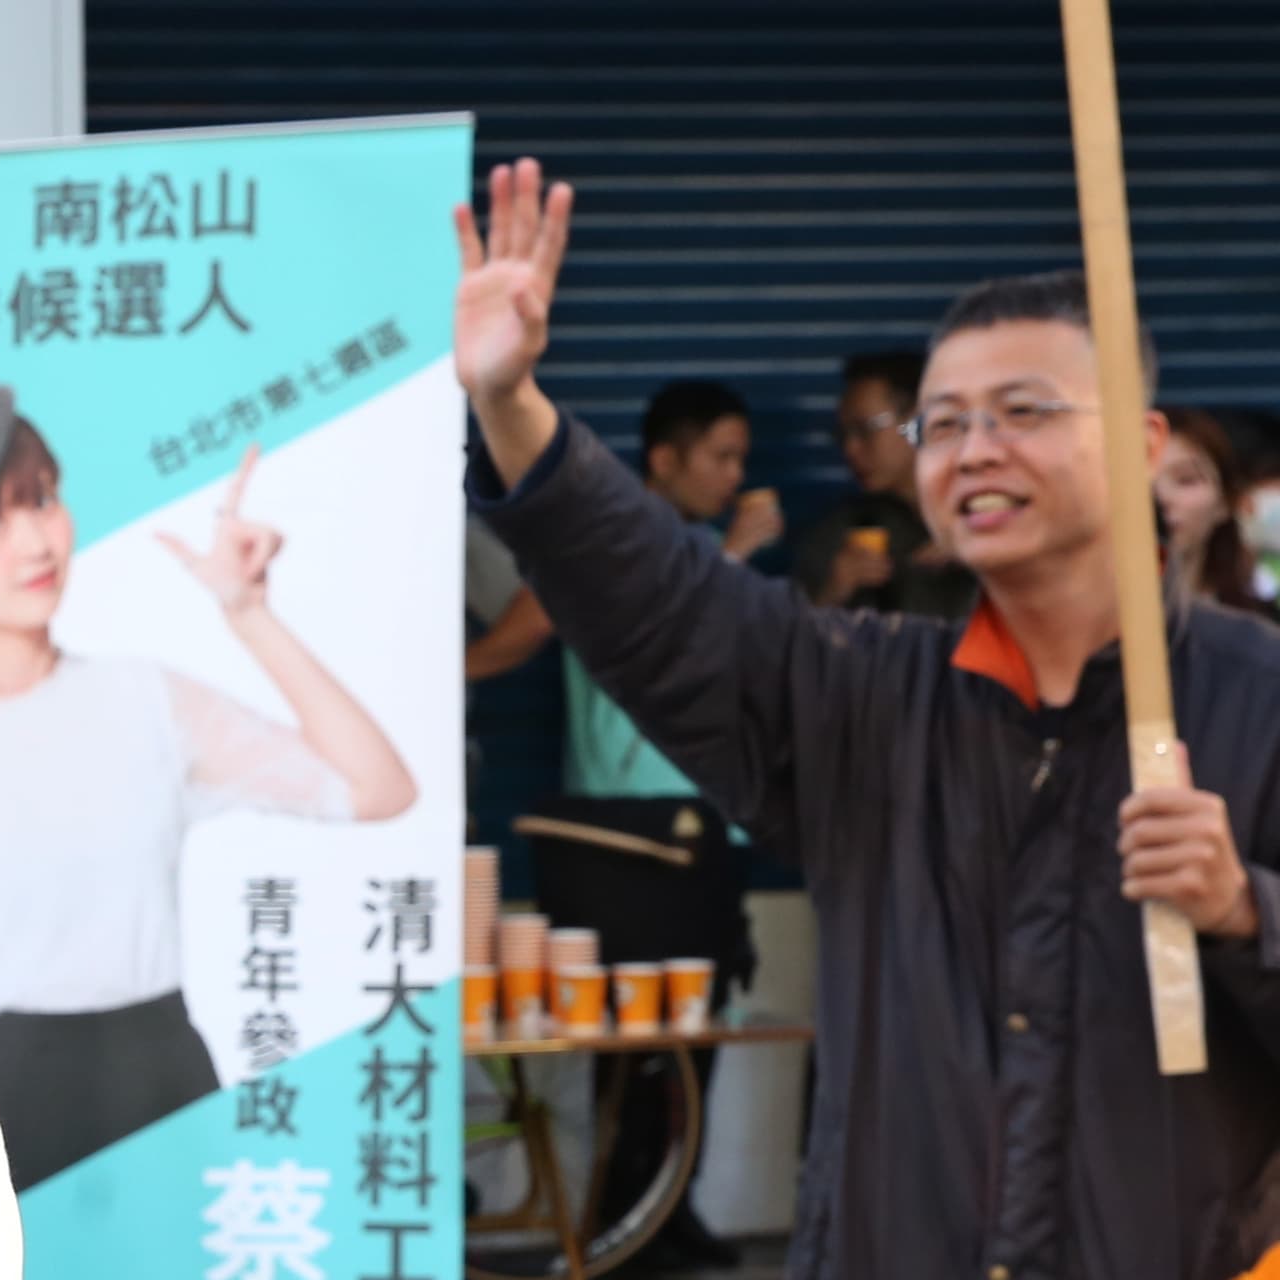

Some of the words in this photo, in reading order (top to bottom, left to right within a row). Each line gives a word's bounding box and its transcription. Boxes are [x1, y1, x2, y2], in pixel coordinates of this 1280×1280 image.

[33, 170, 259, 249] 南松山
[149, 317, 409, 477] 台北市第七選區
[237, 878, 300, 1137] 青年參政
